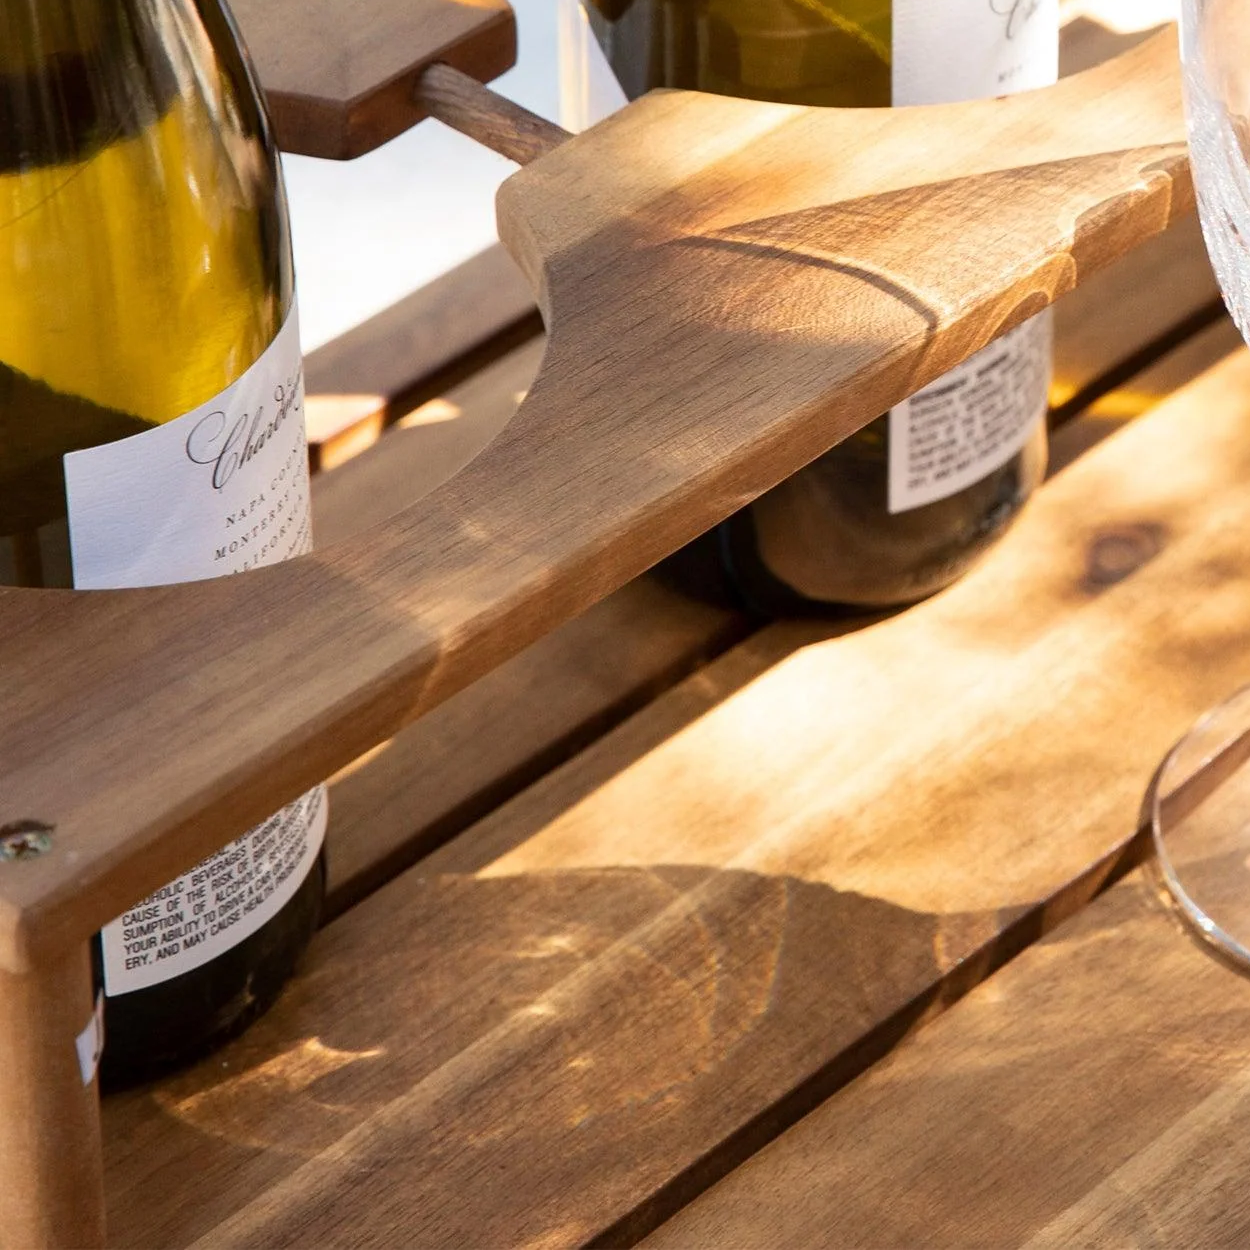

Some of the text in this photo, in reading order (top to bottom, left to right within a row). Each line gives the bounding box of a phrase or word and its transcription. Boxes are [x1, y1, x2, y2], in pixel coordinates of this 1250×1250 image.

[226, 493, 266, 529] NAPA
[191, 844, 246, 887] BEVERAGES
[122, 905, 160, 927] CAUSE
[166, 896, 180, 913] OF
[186, 885, 206, 904] THE
[211, 869, 235, 892] RISK
[238, 857, 249, 874] OF
[124, 936, 158, 956] YOUR
[160, 919, 201, 945] ABILITY
[203, 910, 217, 926] TO
[218, 890, 246, 918] DRIVE
[247, 886, 254, 897] A
[255, 870, 272, 891] CAR
[123, 910, 184, 942] SUMPTION
[193, 900, 206, 916] OF
[155, 942, 181, 962] AND
[183, 928, 209, 951] MAY
[211, 908, 241, 937] CAUSE
